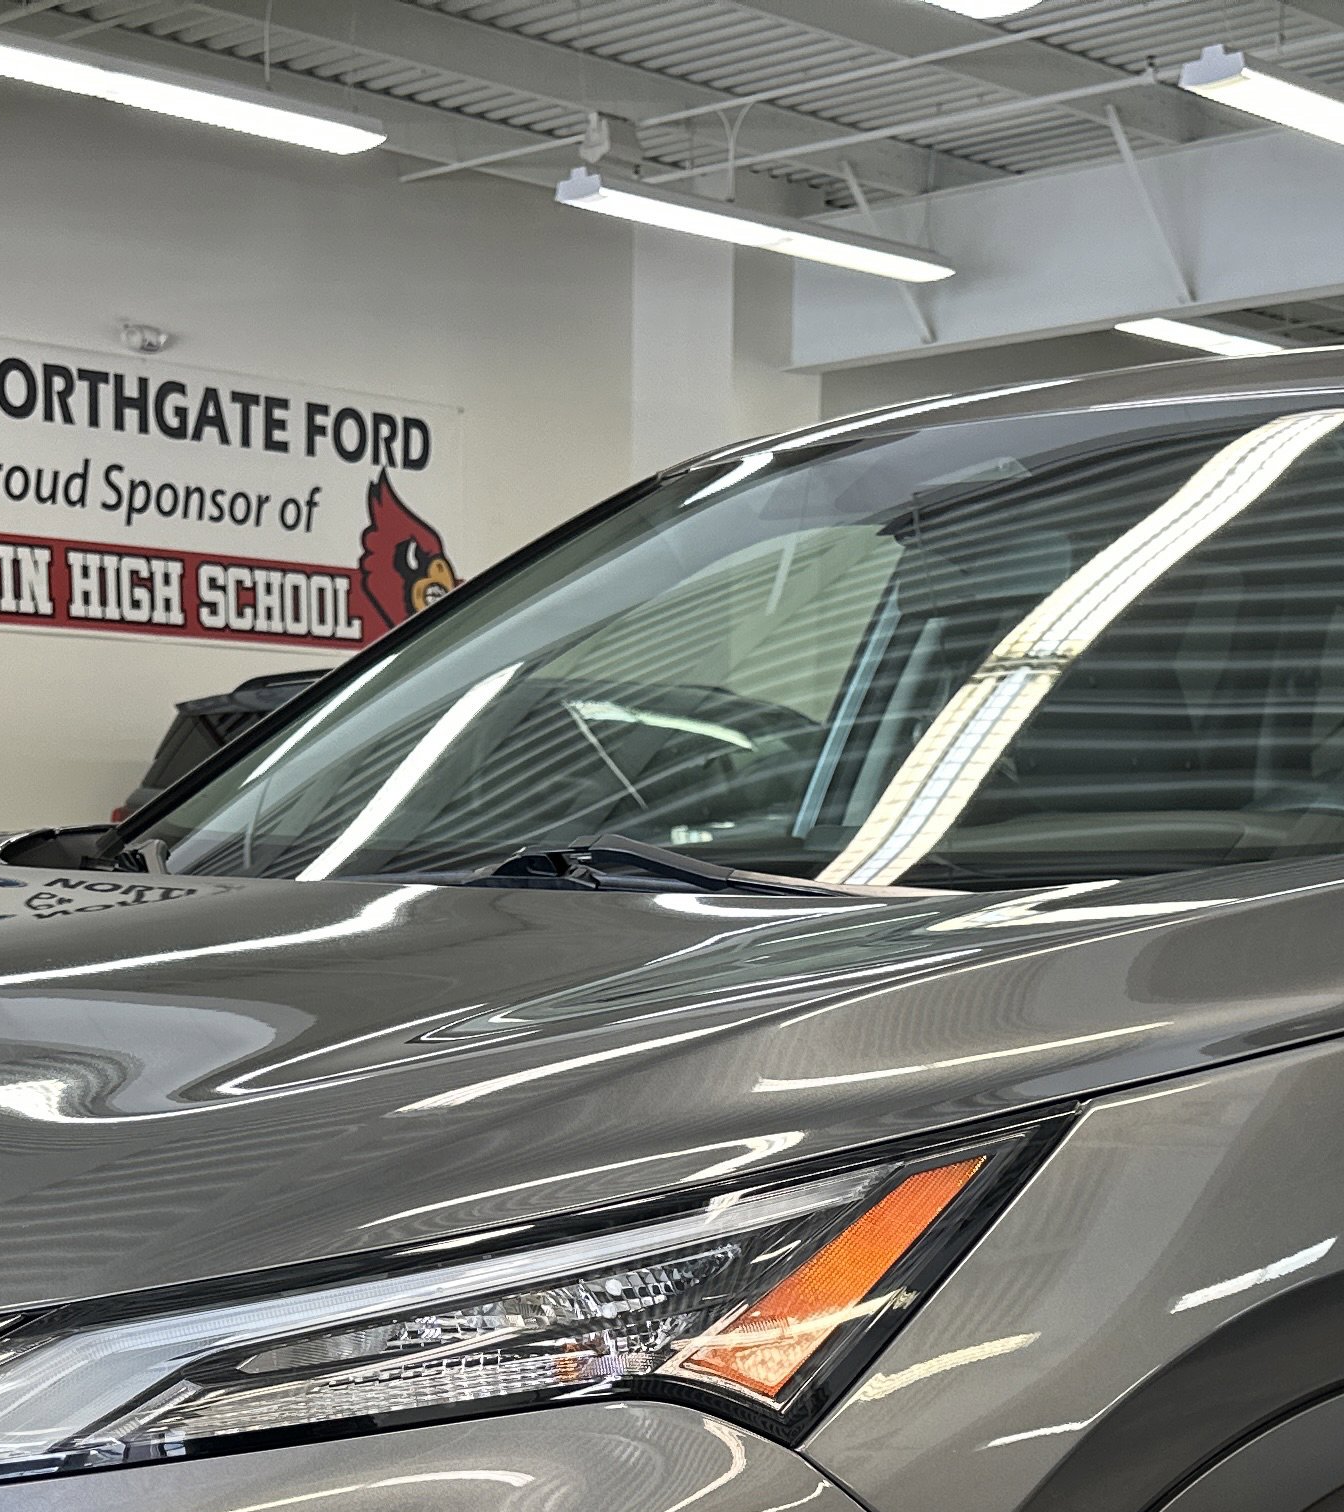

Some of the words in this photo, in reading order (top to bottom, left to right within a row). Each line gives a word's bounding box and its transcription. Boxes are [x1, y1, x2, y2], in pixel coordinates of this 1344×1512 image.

[305, 405, 432, 472] FORD
[101, 463, 271, 526] Sponsor
[279, 486, 322, 532] of
[67, 550, 184, 627] HIGH
[196, 561, 362, 641] SCHOOL
